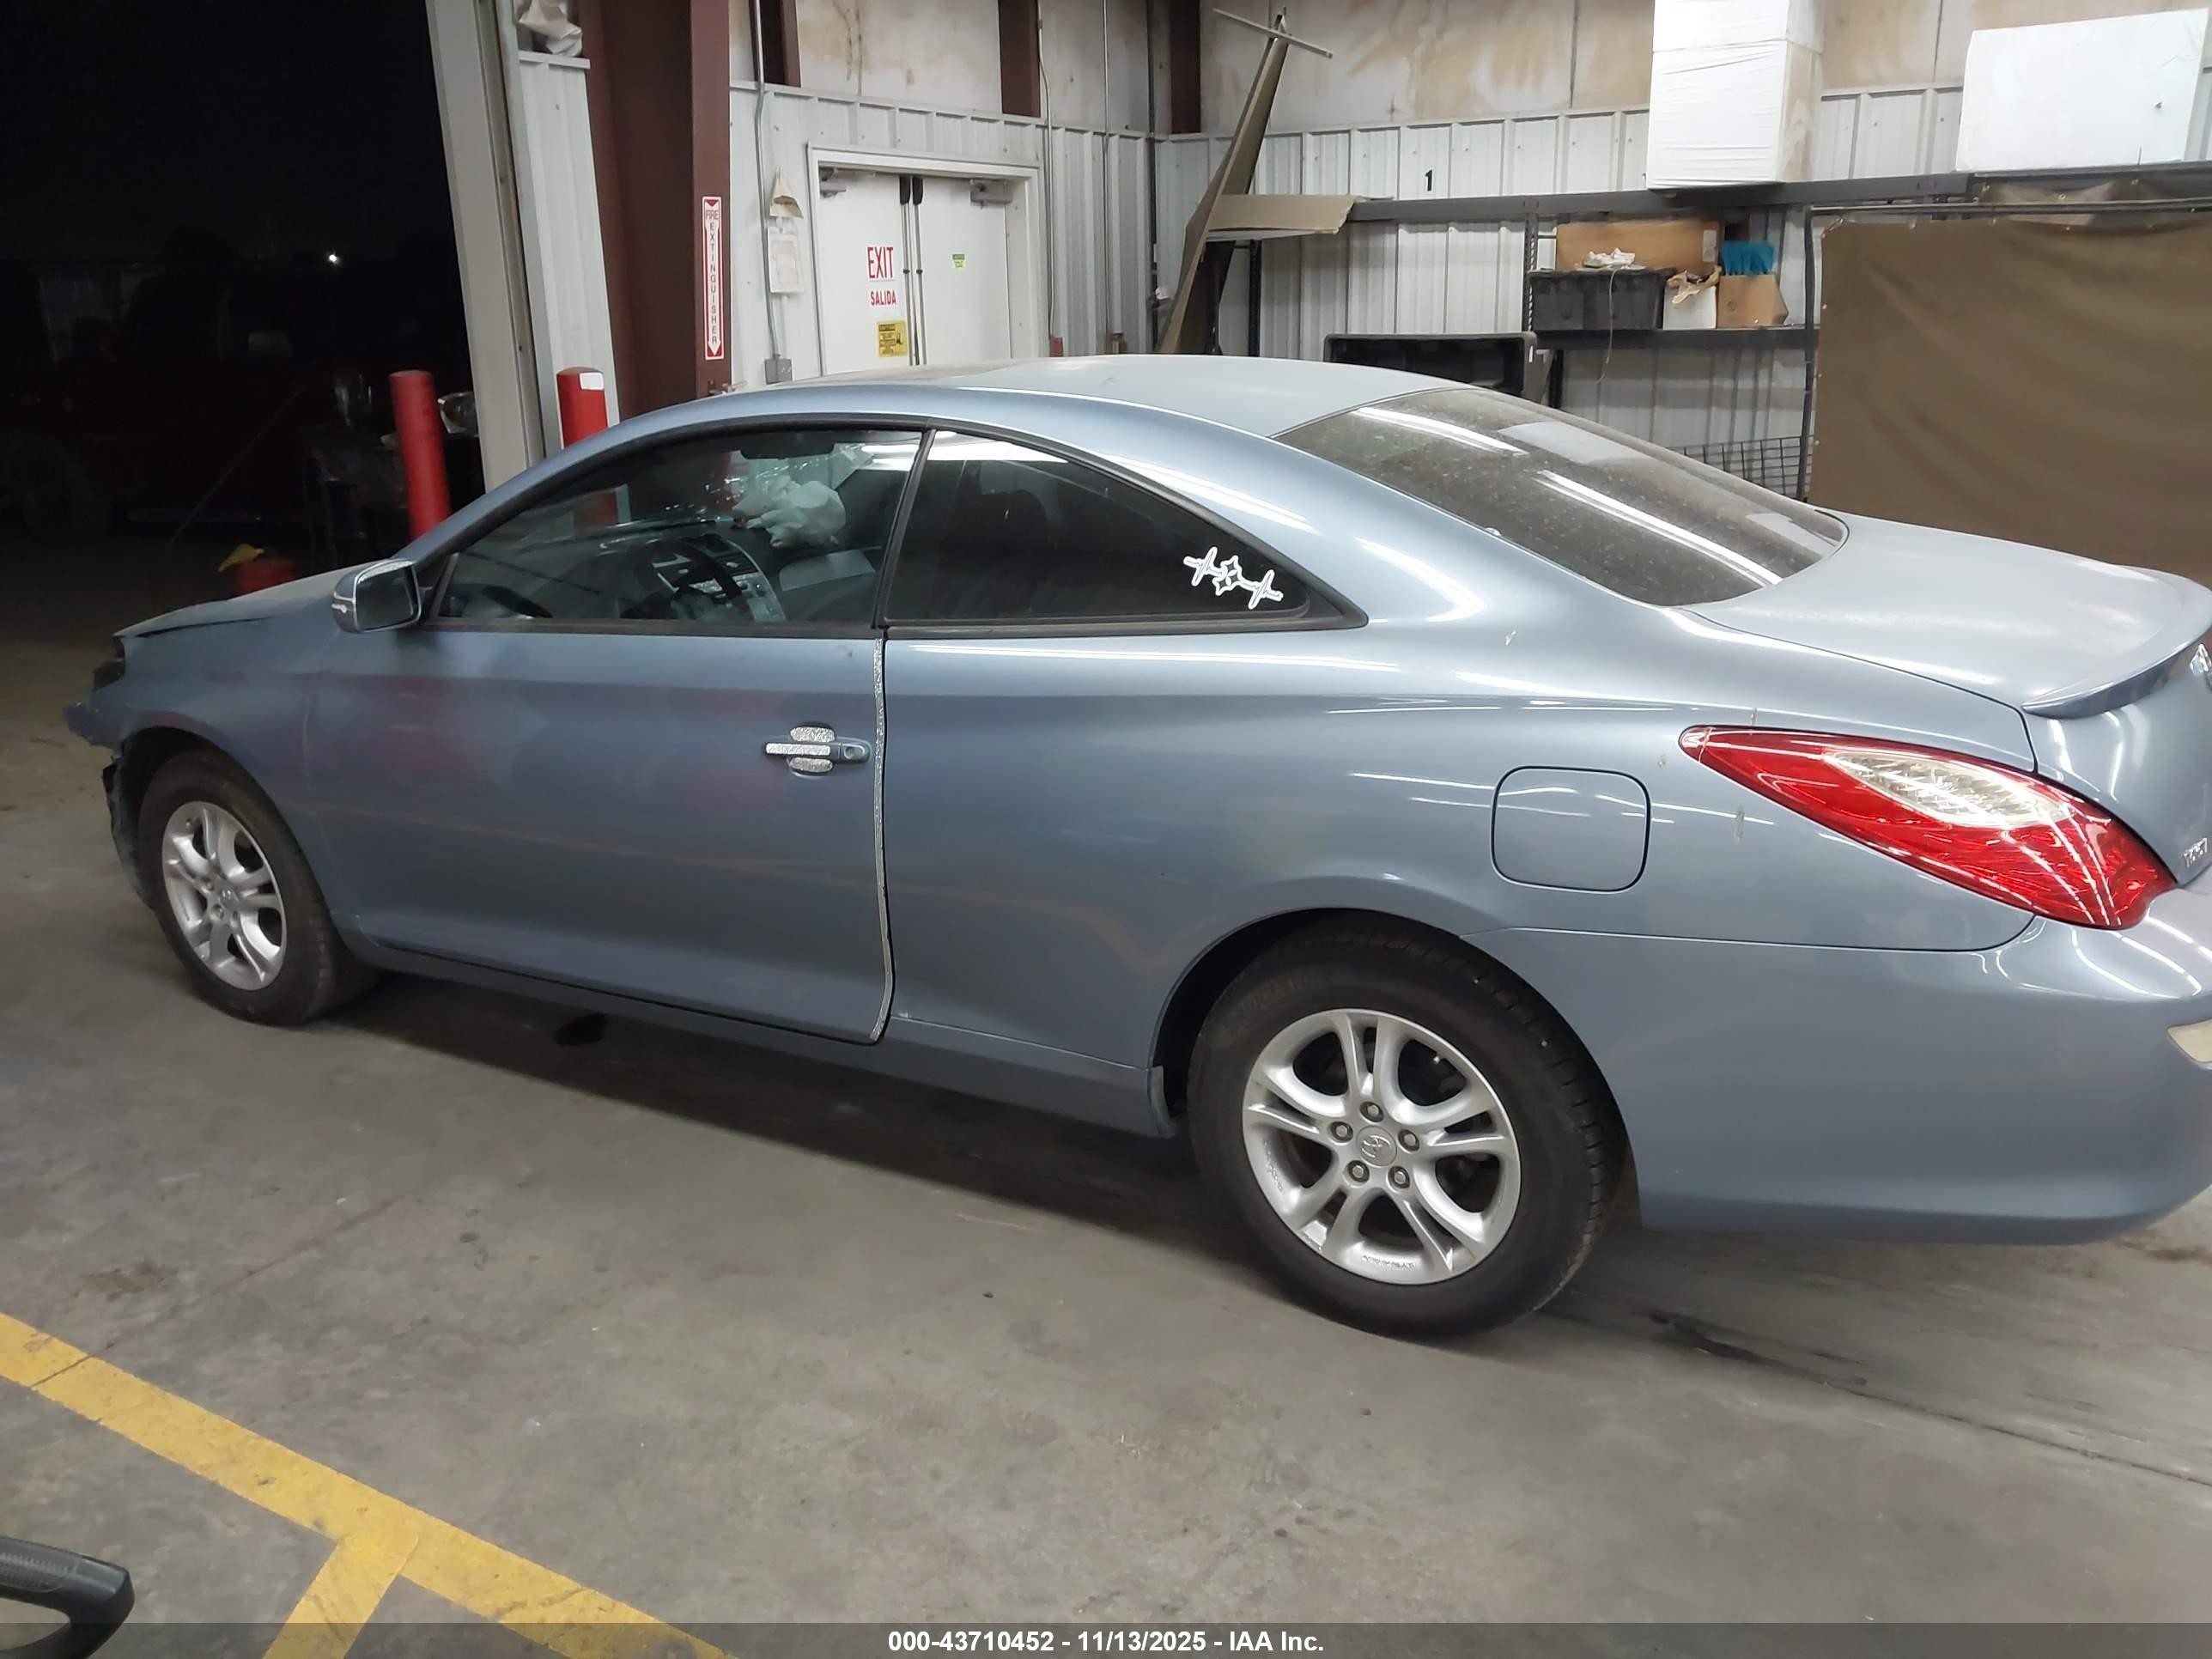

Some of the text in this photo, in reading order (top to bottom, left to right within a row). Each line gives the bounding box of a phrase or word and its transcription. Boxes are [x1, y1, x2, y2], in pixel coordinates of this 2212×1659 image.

[1425, 169, 1433, 191] 1
[705, 210, 719, 221] FIRE
[866, 246, 894, 279] EXIT
[709, 222, 718, 344] EXTINGUISHER
[870, 289, 896, 306] SALIDA
